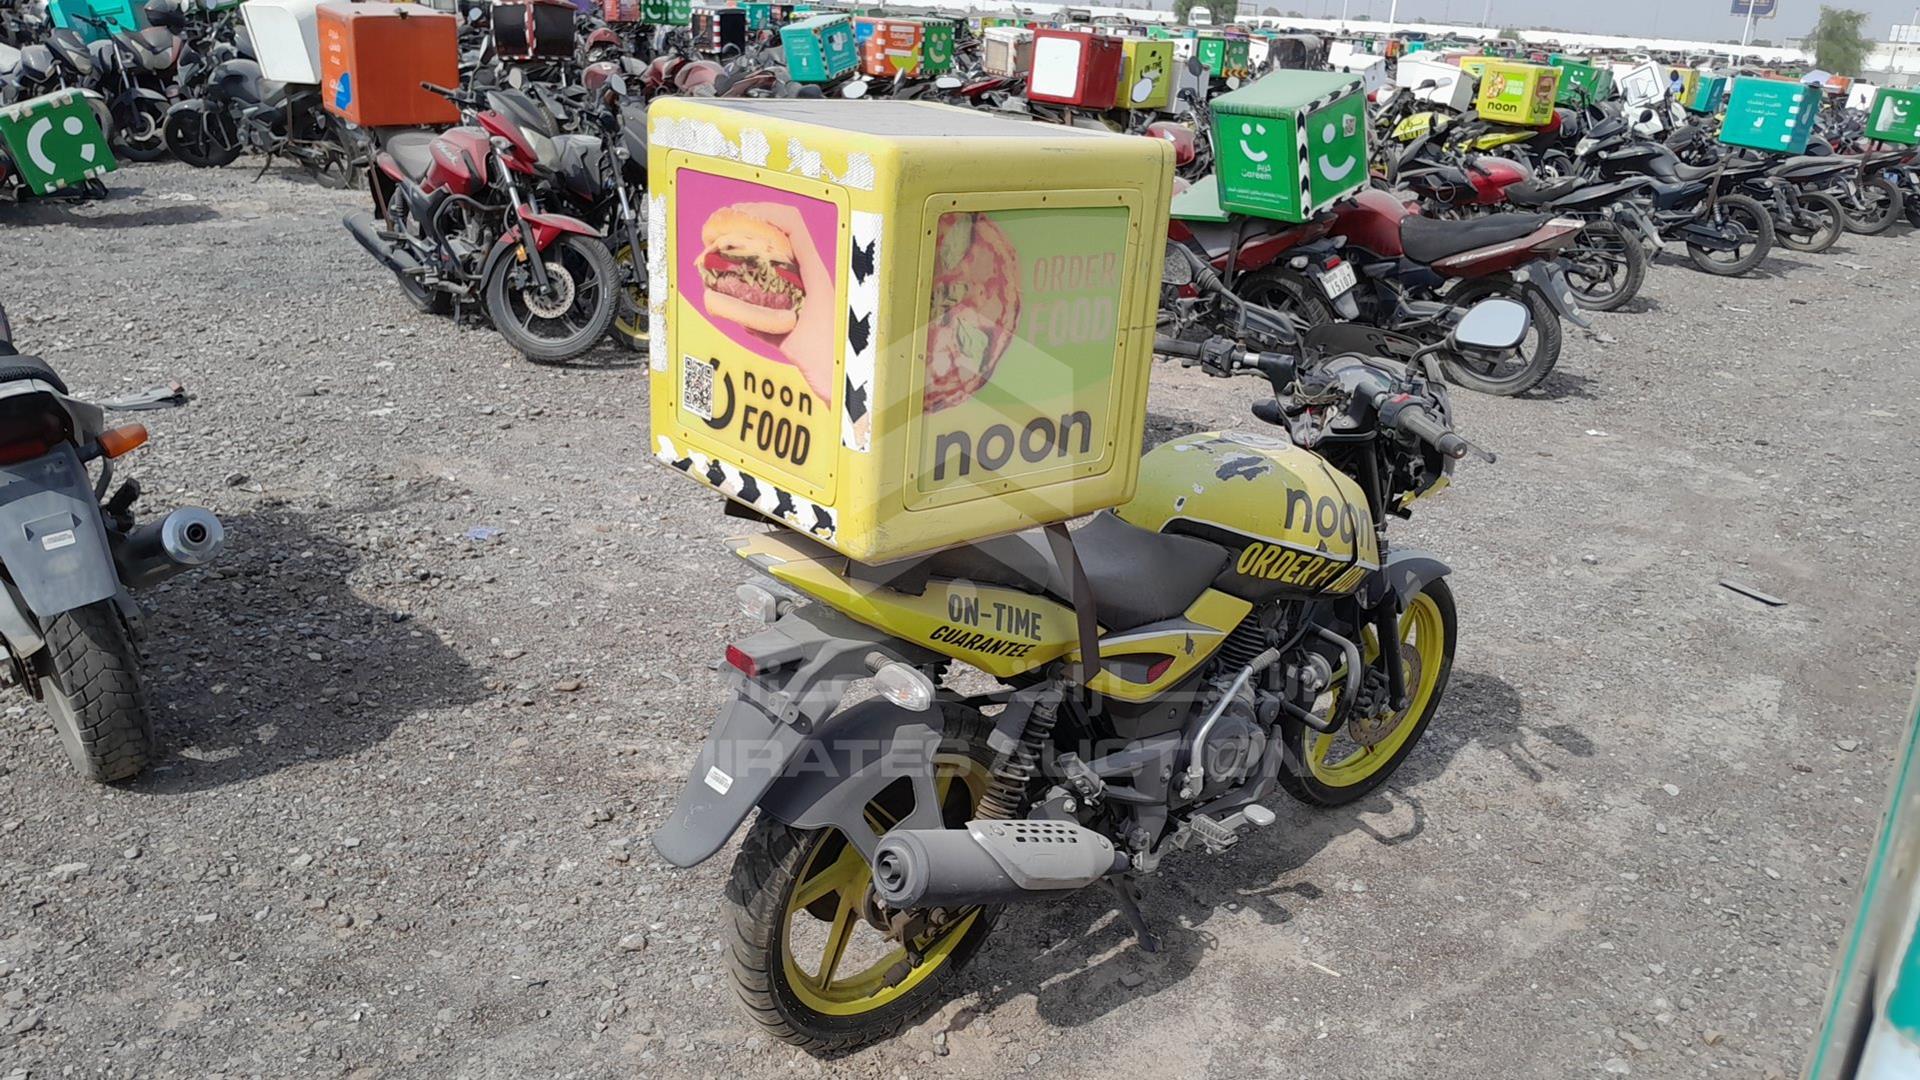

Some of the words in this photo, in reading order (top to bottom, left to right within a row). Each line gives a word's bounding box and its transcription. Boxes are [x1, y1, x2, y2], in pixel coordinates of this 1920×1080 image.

[1487, 101, 1517, 113] noon
[1032, 251, 1117, 293] ORDER
[1026, 297, 1115, 348] FOOD
[744, 371, 812, 416] noon
[740, 404, 811, 466] FOOD
[933, 410, 1092, 482] noon
[1284, 488, 1370, 551] noon
[1236, 541, 1326, 587] ORDER
[948, 594, 1042, 641] ON-TIME
[929, 625, 1037, 658] GUARANTEE
